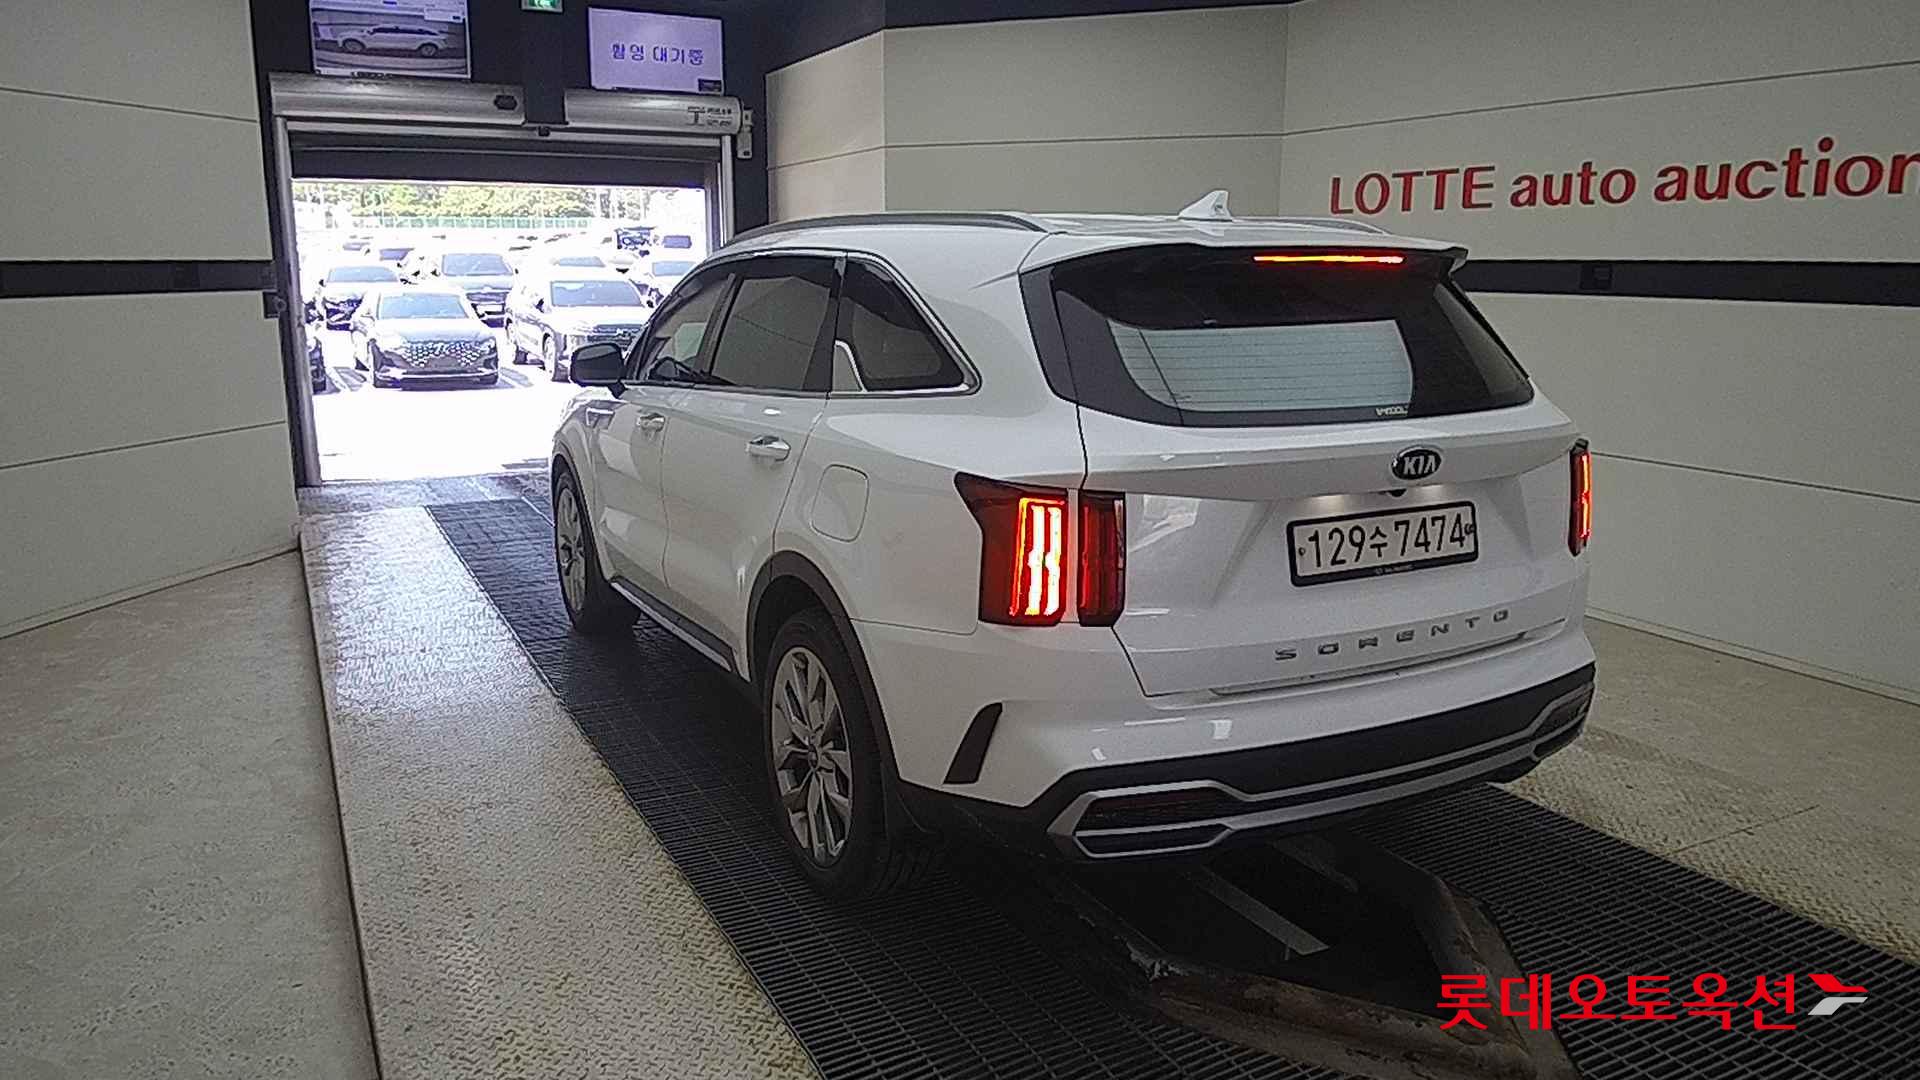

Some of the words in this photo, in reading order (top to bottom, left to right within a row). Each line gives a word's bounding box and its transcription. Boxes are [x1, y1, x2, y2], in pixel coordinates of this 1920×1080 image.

[653, 45, 704, 66] 대기중
[1330, 165, 1495, 214] LOTTE
[1510, 161, 1636, 206] auto
[1403, 455, 1436, 475] KIA
[1274, 609, 1509, 660] SORENTO
